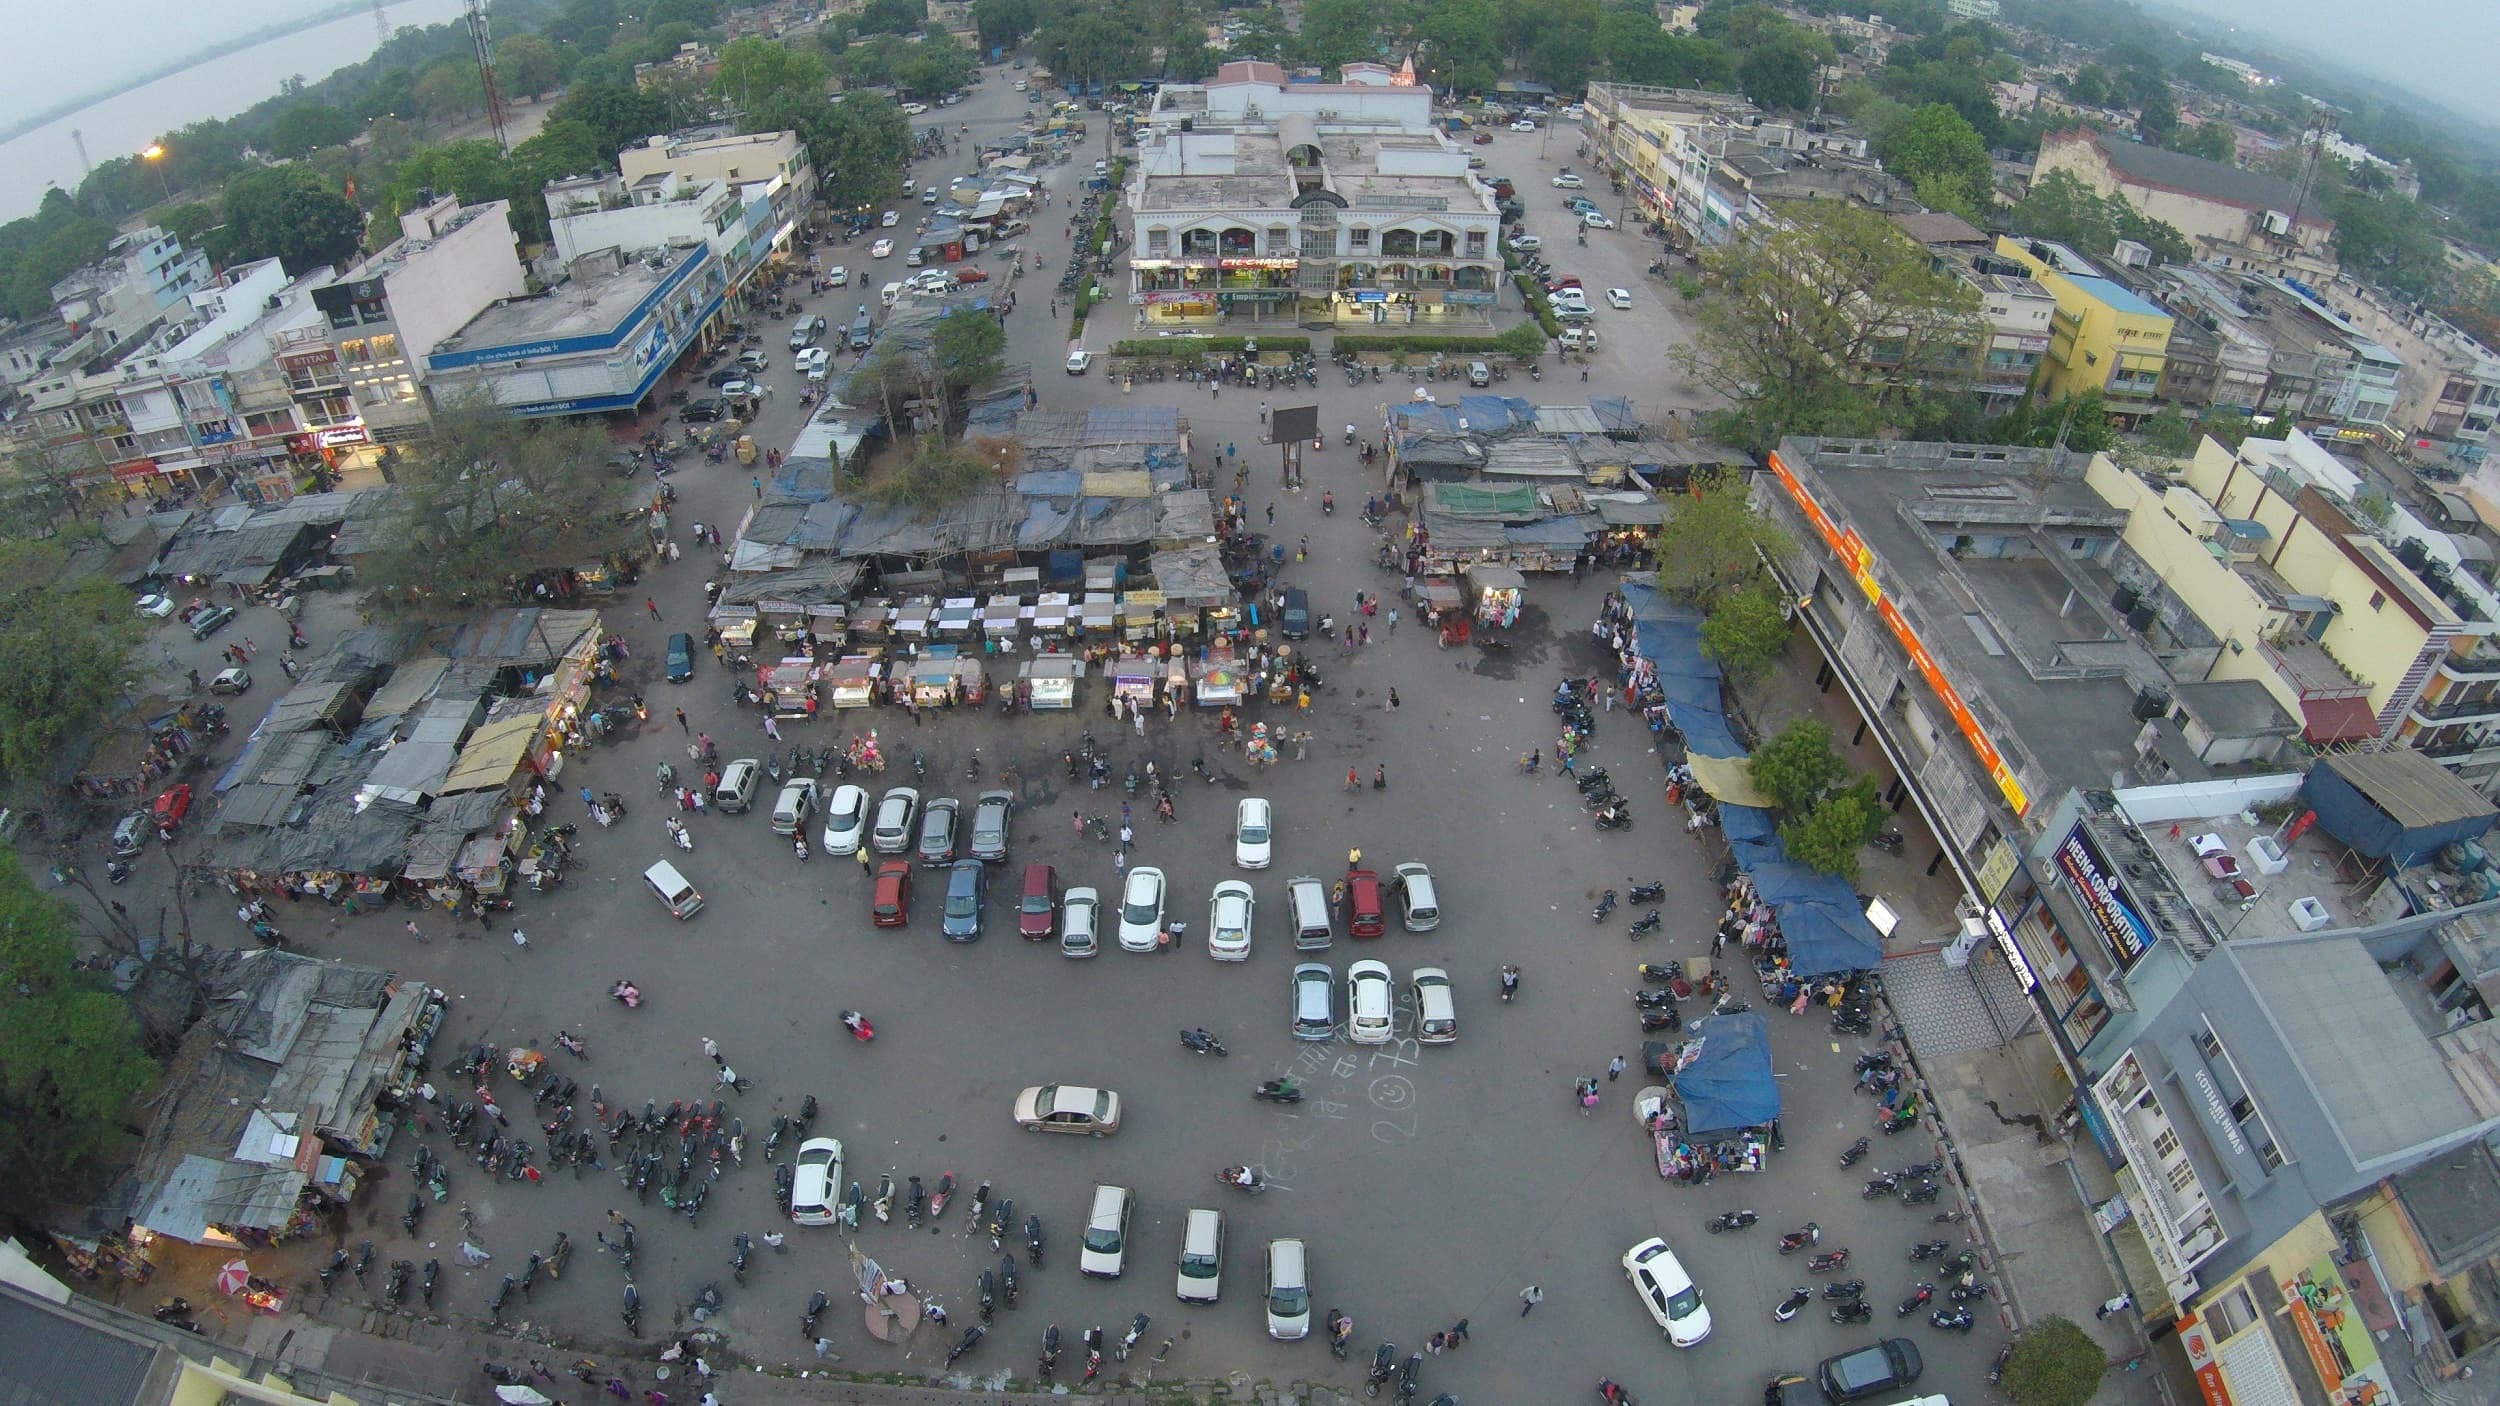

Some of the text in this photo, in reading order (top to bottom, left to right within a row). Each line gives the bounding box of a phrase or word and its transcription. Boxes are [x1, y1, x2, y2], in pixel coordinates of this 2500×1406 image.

[1246, 257, 1298, 268] CHAMPS
[1232, 293, 1258, 301] Empire
[300, 353, 328, 367] TITAN
[2066, 836, 2144, 956] HEENA CORPORATION
[2195, 1069, 2225, 1121] KOTHARI
[2221, 1117, 2245, 1156] NIWAS
